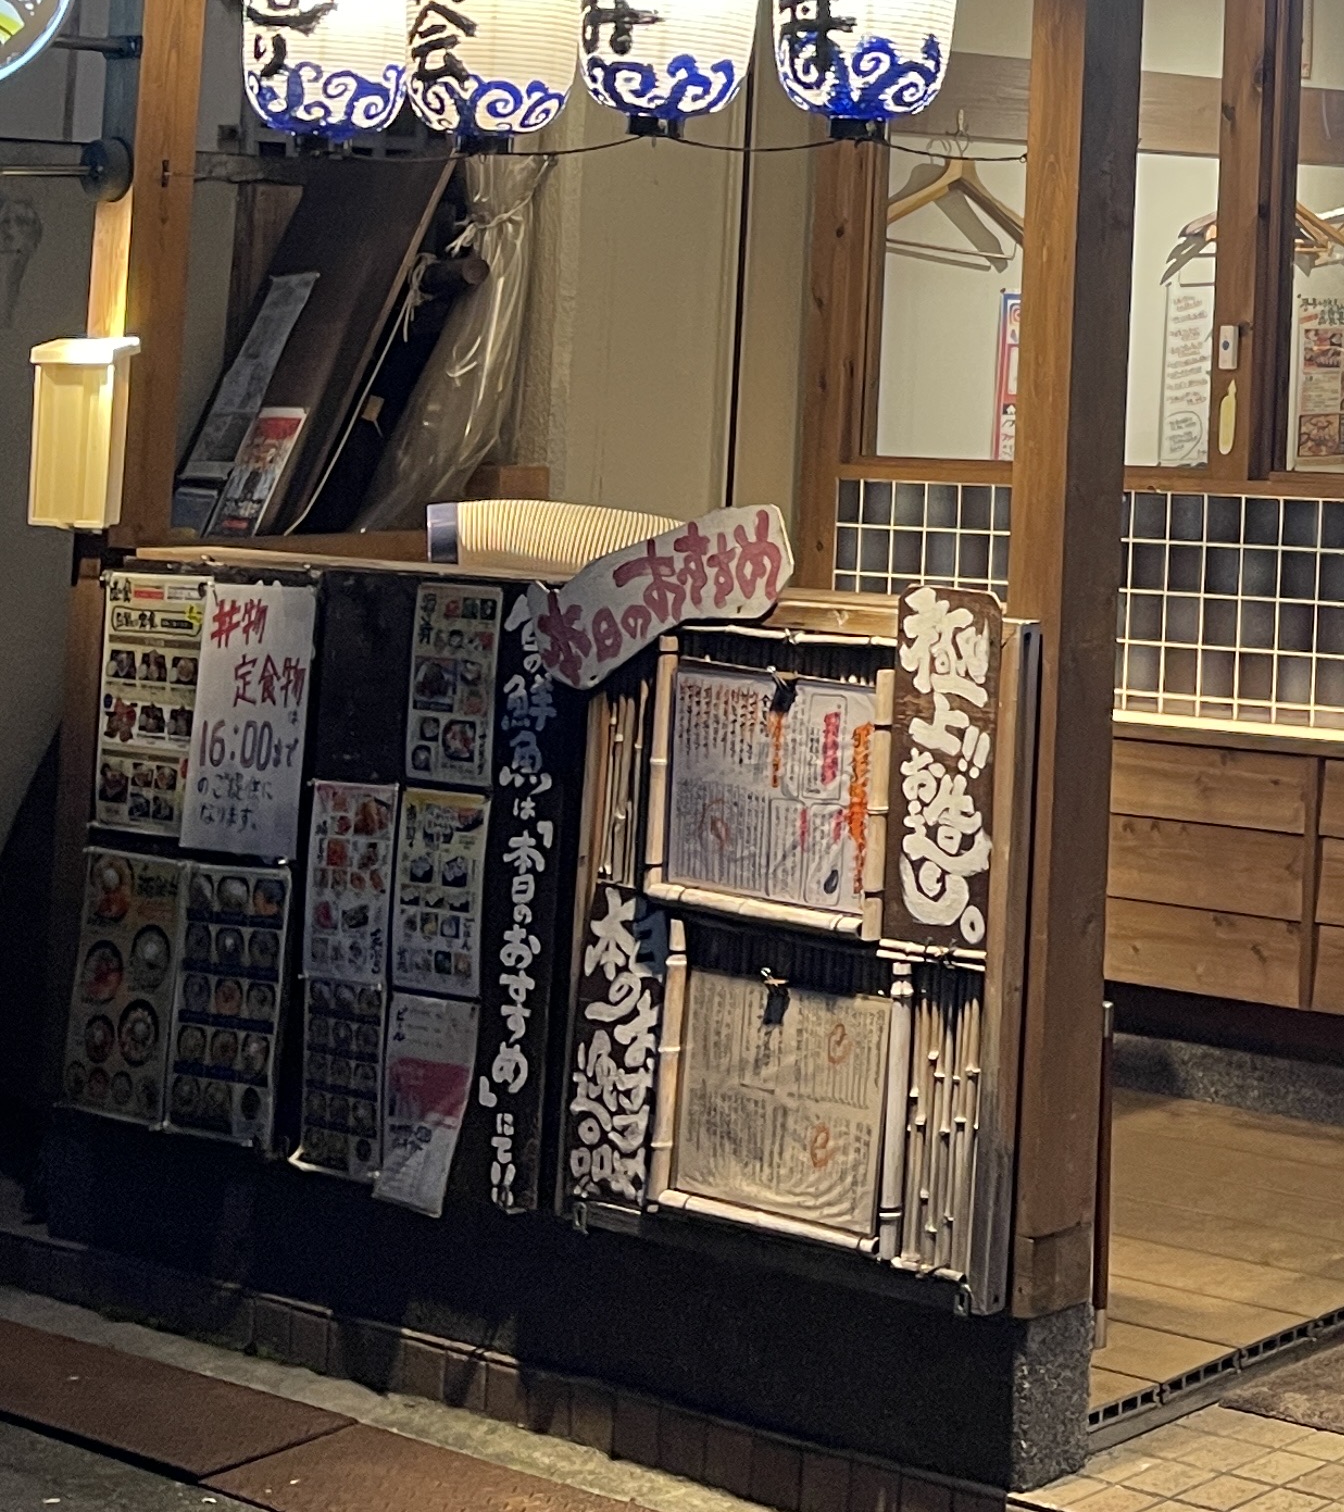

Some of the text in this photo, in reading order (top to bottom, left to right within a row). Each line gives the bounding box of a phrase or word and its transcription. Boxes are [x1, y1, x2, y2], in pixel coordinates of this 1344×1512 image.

[210, 597, 269, 649] 丼物
[537, 509, 782, 687] 本日のおすすめ
[233, 654, 306, 709] 定食物
[199, 719, 299, 771] 16:00まで
